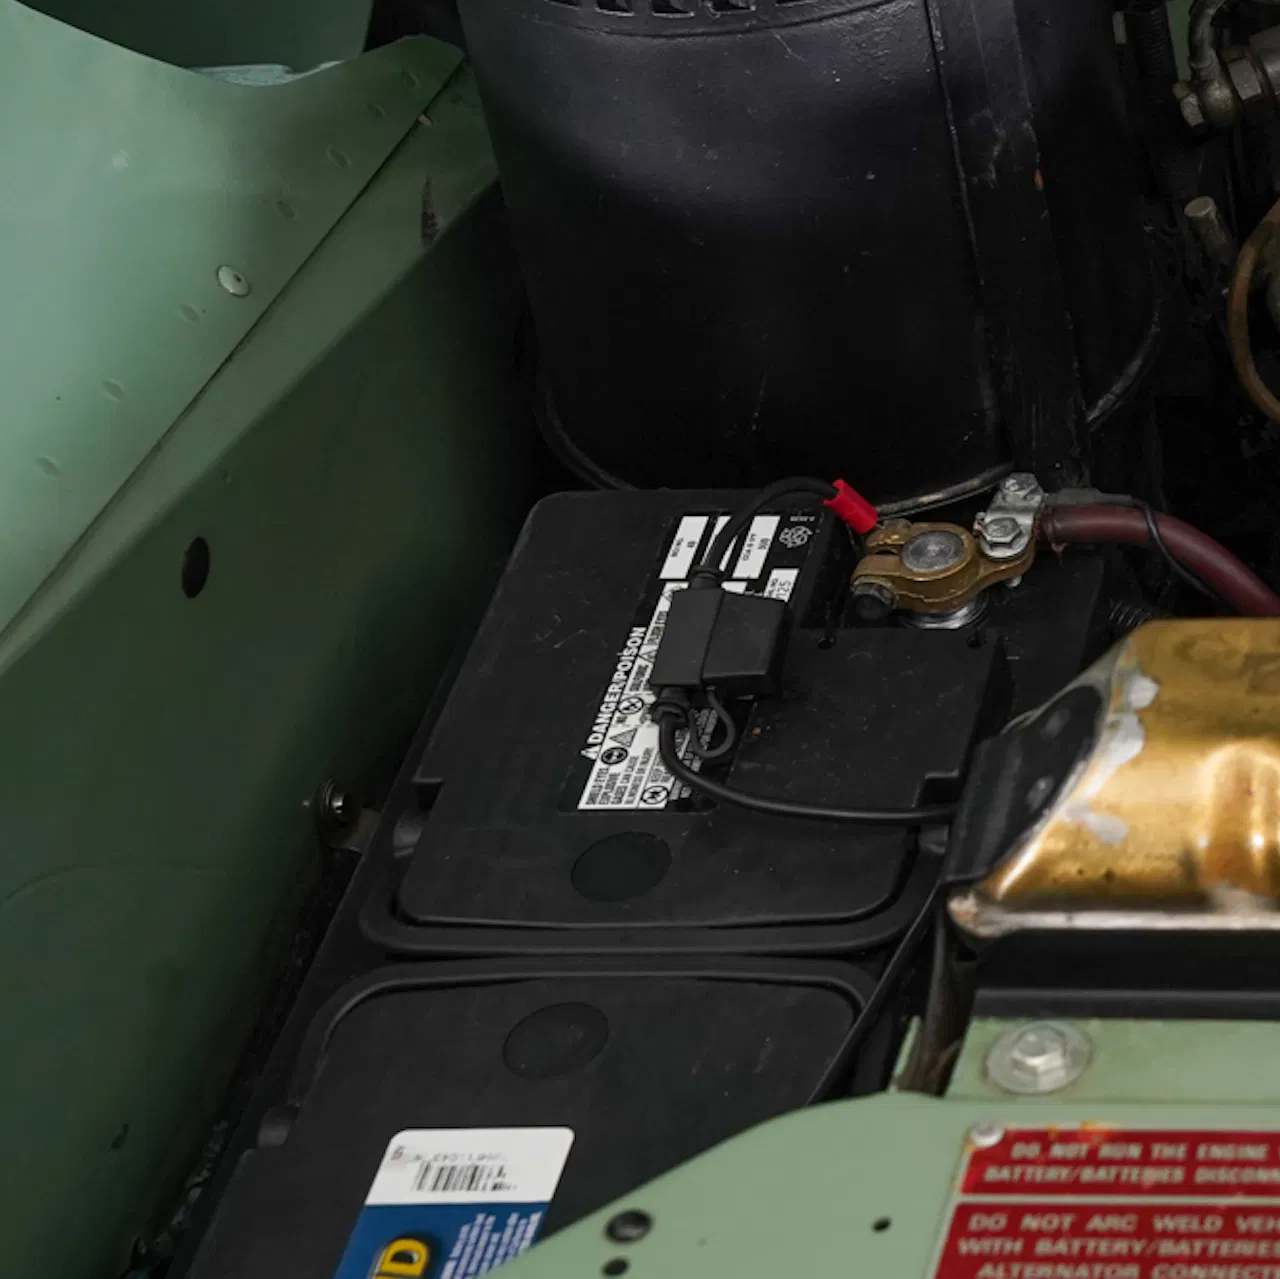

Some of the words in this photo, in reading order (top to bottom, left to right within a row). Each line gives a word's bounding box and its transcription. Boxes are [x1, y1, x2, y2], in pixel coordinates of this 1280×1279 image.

[587, 626, 648, 744] DANGER/POISON
[1011, 1142, 1042, 1160] DO
[1049, 1142, 1088, 1160] NOT
[1097, 1142, 1143, 1161] RUN
[1151, 1142, 1189, 1160] THE
[1196, 1143, 1269, 1161] ENGINE
[983, 1165, 1186, 1184] BATTERY/BATTERIES
[967, 1212, 1008, 1232] DO
[1019, 1213, 1077, 1232] NOT
[1085, 1213, 1139, 1232] ARC
[1152, 1214, 1224, 1233] WELD
[957, 1236, 1024, 1256] WITH
[975, 1261, 1141, 1279] ALTERNATOR
